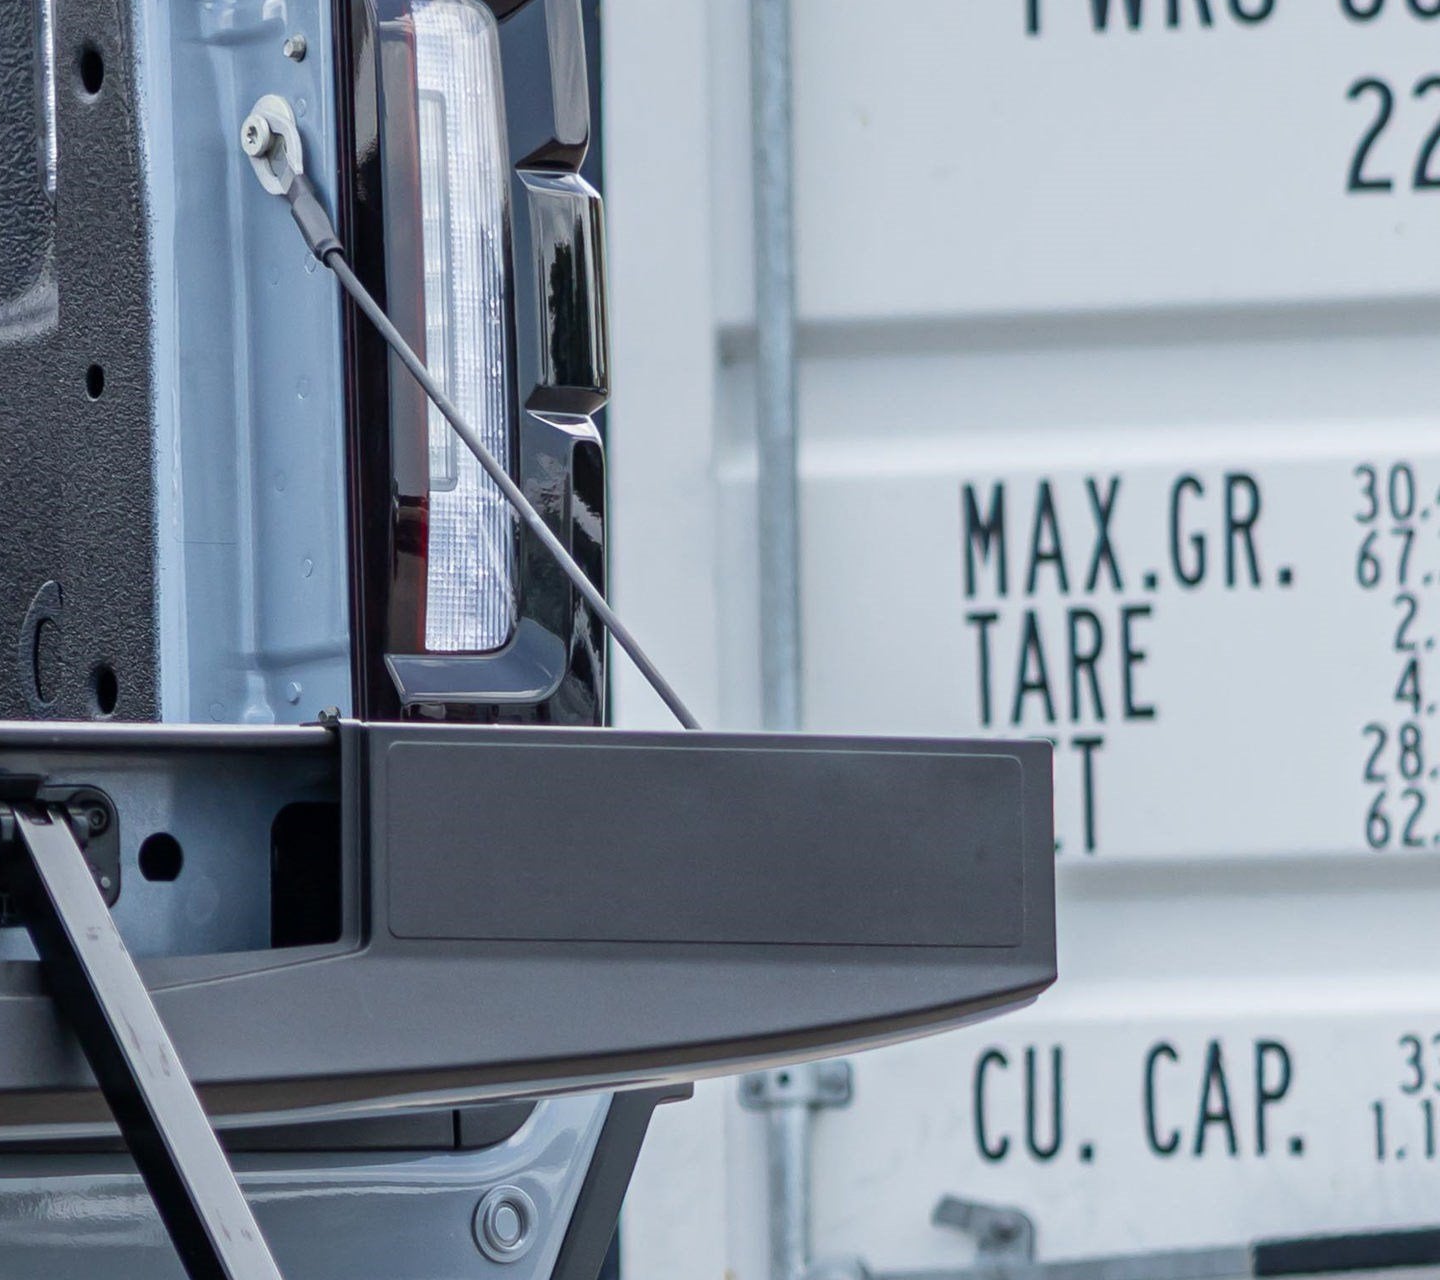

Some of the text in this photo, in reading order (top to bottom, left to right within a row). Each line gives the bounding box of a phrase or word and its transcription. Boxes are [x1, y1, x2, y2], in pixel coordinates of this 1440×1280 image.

[962, 472, 1294, 599] MAX.GR.
[964, 605, 1157, 727] TARE
[973, 1045, 1096, 1163] CU.
[1143, 1036, 1306, 1157] CAP.
